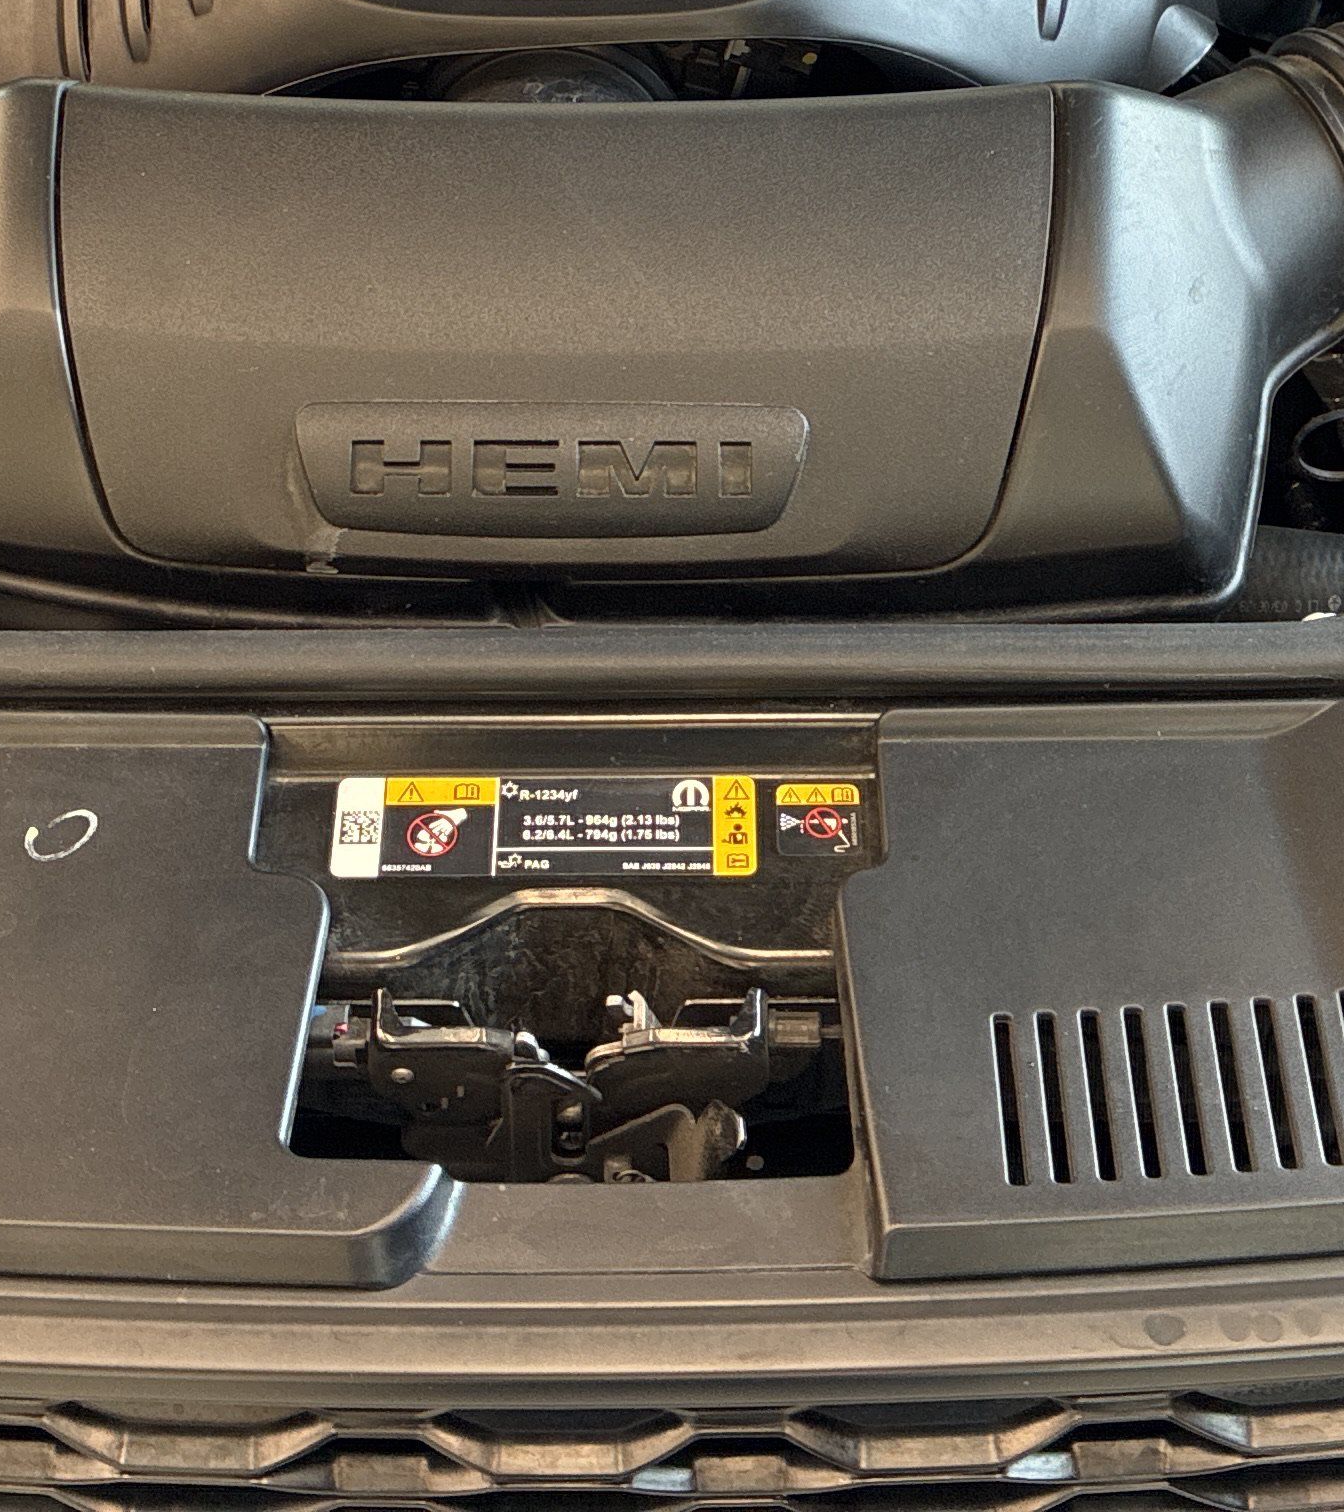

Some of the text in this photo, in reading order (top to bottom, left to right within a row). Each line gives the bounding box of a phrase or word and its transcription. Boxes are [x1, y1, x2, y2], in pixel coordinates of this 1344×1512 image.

[349, 439, 754, 498] HEMI
[519, 789, 579, 802] R-1234yf
[523, 814, 575, 826] 3.6/5.7L
[621, 814, 653, 828] (2.13
[655, 814, 680, 828] lbs)
[522, 829, 575, 840] 6.2/6.4L
[620, 829, 653, 842] (1.75
[655, 829, 680, 842] lbs)
[523, 859, 550, 870] PAG
